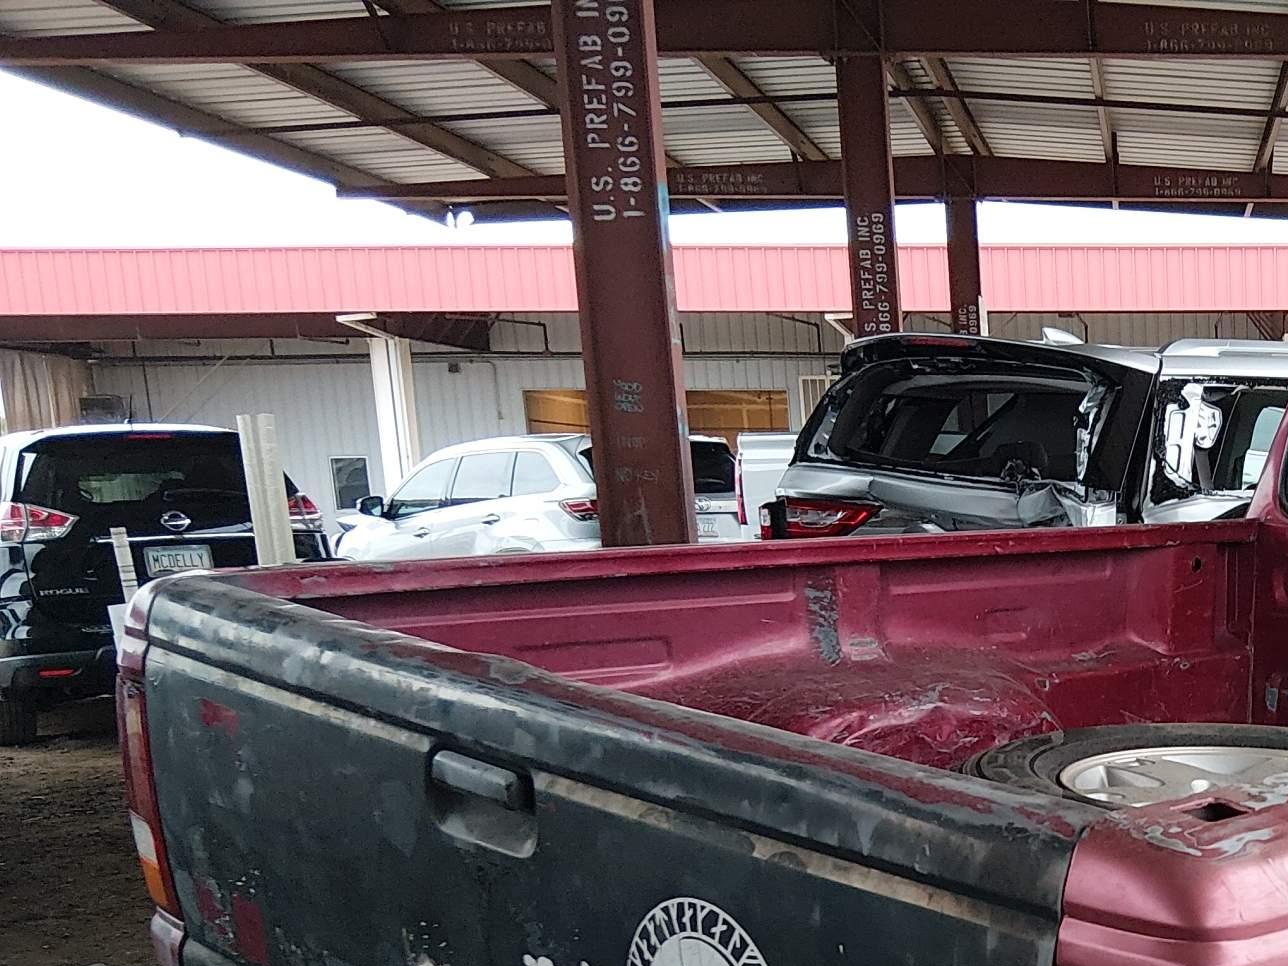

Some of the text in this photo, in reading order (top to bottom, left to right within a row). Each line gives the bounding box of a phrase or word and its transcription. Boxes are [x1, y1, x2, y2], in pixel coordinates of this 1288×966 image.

[578, 33, 611, 149] PREFAB
[604, 0, 645, 218] 1-866-799-09
[591, 166, 617, 221] U.S.
[859, 249, 876, 310] PREFAB
[152, 553, 206, 569] MCDELLY
[39, 588, 90, 598] ROGUE
